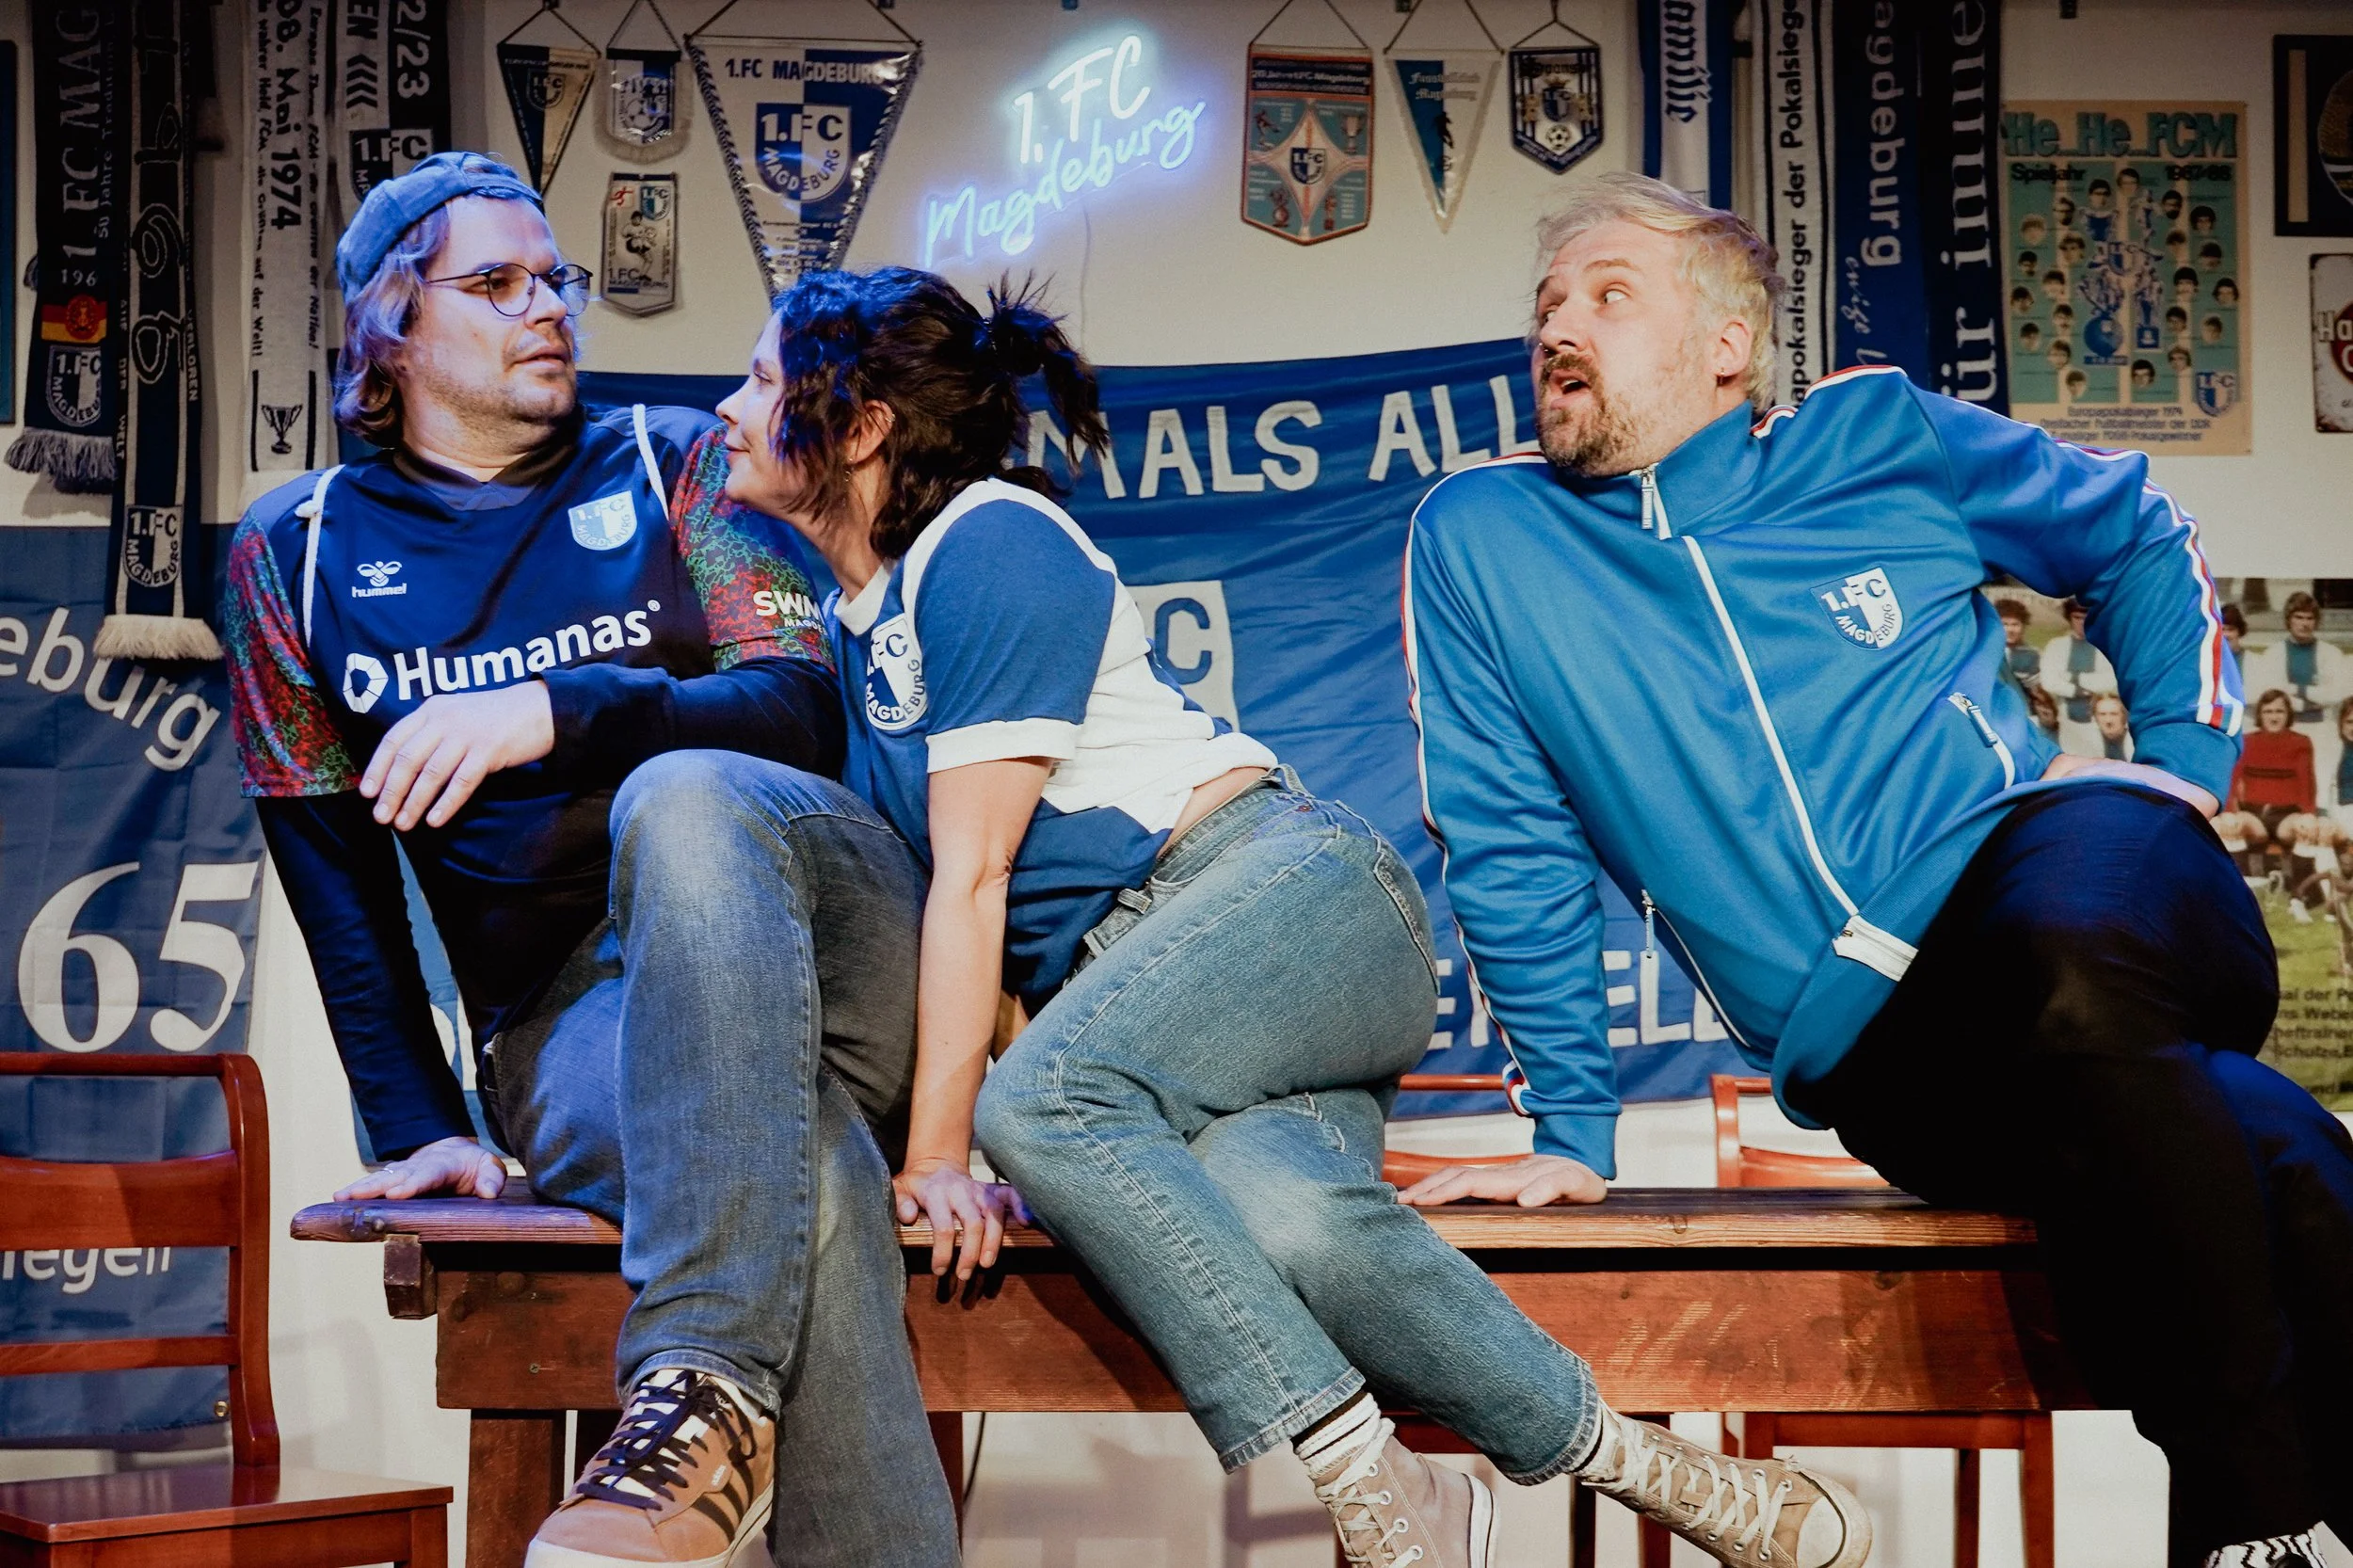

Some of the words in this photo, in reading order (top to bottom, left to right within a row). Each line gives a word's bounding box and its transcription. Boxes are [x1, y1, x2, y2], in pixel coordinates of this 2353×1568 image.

[276, 68, 303, 136] Mai
[355, 136, 428, 162] 1.FC
[760, 112, 844, 142] 1.FC
[2147, 112, 2238, 158] FCM
[62, 147, 100, 213] FC
[270, 148, 302, 231] 1974
[763, 147, 842, 193] MAGDEBURG
[924, 101, 1207, 270] Magdeburg
[1784, 161, 1805, 209] der
[2011, 163, 2087, 184] Spieljahr
[252, 286, 264, 310] der
[115, 414, 127, 460] WELT
[130, 513, 177, 537] 1.FC
[126, 539, 178, 586] MAGDEBURG
[351, 583, 407, 598] hummel
[1820, 578, 1887, 612] 1.FC
[1834, 603, 1896, 645] MAGDEBURG
[392, 610, 653, 701] Humanas
